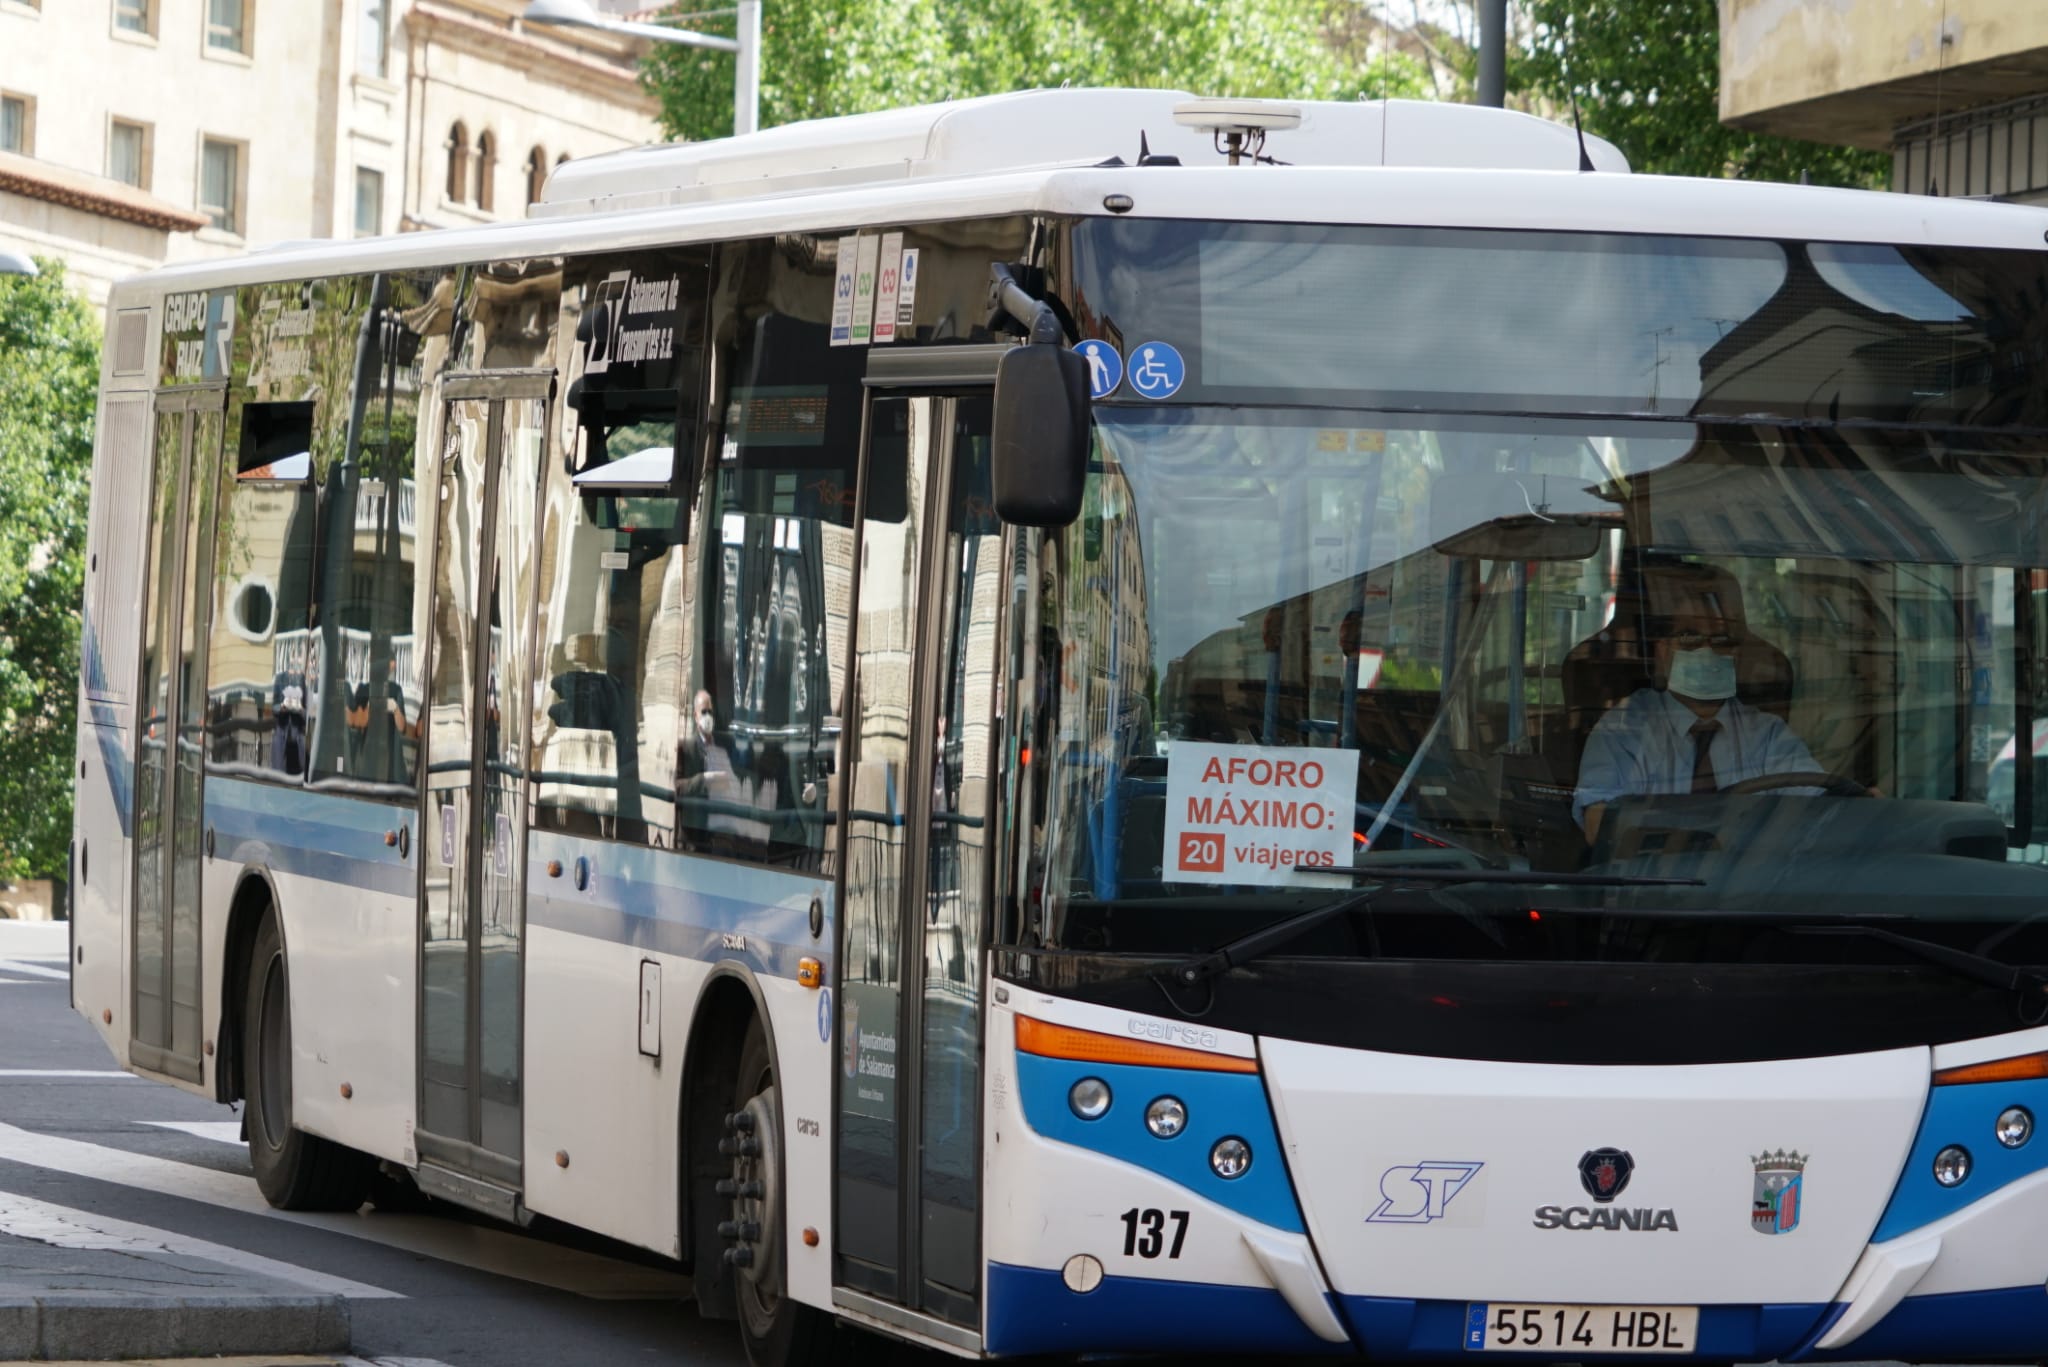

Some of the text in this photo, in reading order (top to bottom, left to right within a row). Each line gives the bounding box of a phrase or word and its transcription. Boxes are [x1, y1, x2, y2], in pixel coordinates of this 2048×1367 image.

[628, 272, 680, 315] Salamanca de
[165, 293, 208, 333] GRUPO
[176, 340, 205, 378] RUIZ
[616, 322, 661, 368] Transportes
[1201, 756, 1325, 789] AFORO
[1187, 792, 1335, 830] MÁXIMO:
[1184, 839, 1334, 871] 20 viajeros
[858, 1028, 896, 1054] Ayuntamiento
[1127, 1017, 1218, 1049] carsa
[858, 1054, 896, 1080] de Salamanca
[796, 1116, 820, 1138] carsa
[1120, 1207, 1190, 1259] 137
[1532, 1205, 1679, 1232] SCANIA
[1496, 1308, 1593, 1348] 5514
[1611, 1311, 1685, 1349] HBL
